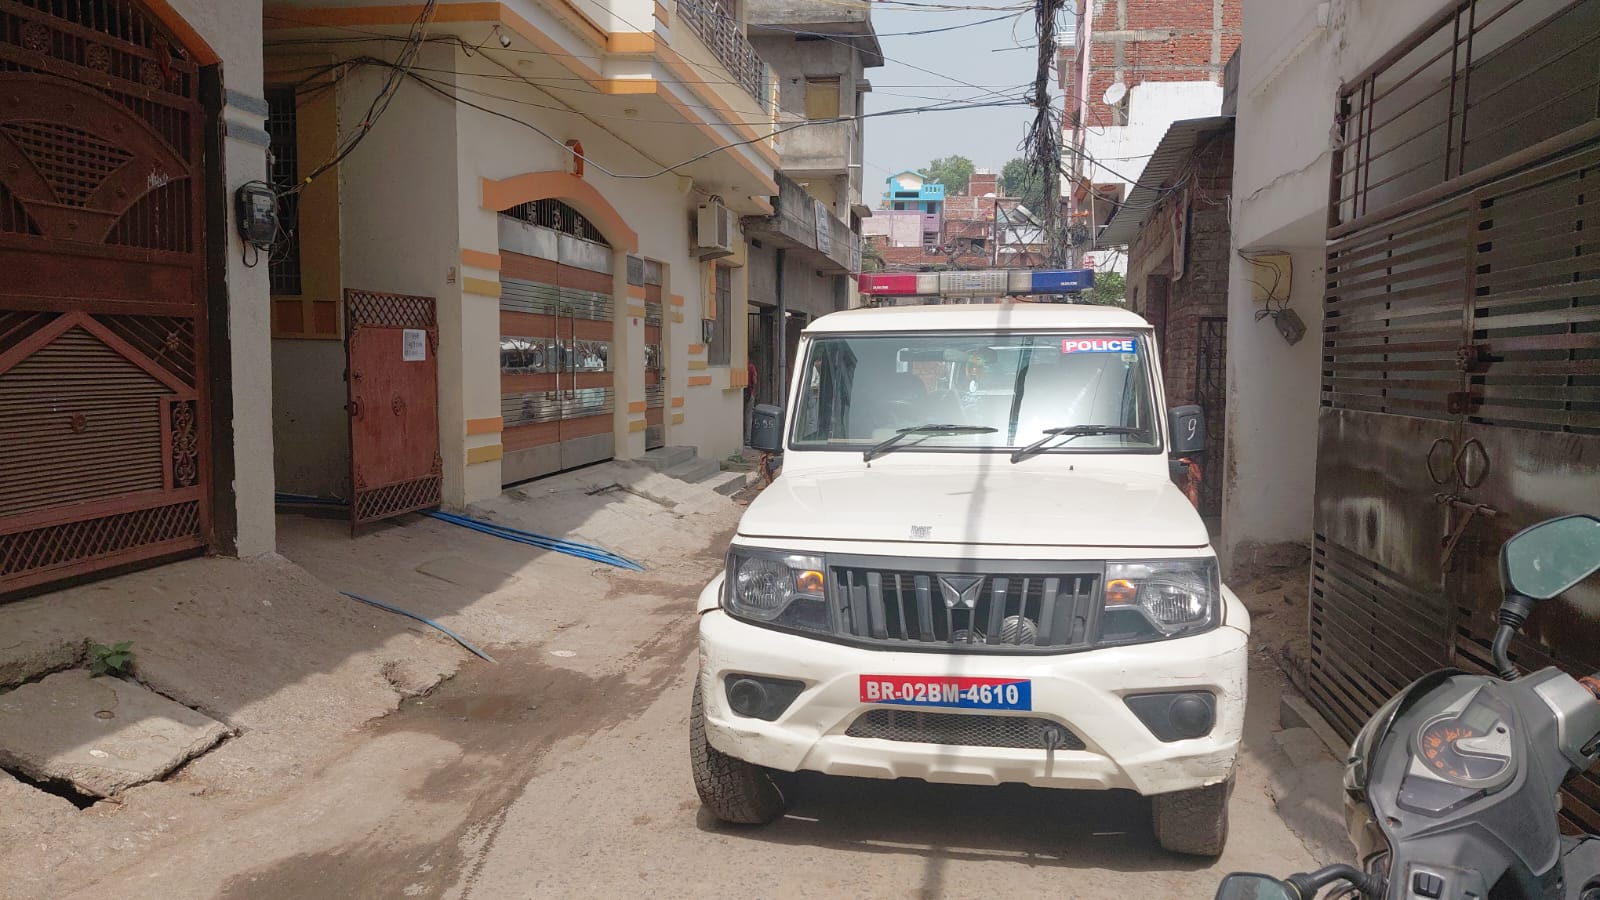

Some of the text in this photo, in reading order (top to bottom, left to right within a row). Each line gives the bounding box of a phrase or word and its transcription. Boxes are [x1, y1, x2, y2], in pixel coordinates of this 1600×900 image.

[1065, 340, 1133, 352] POLICE
[1187, 418, 1197, 441] 9
[866, 681, 1019, 705] BR-02BM-4610
